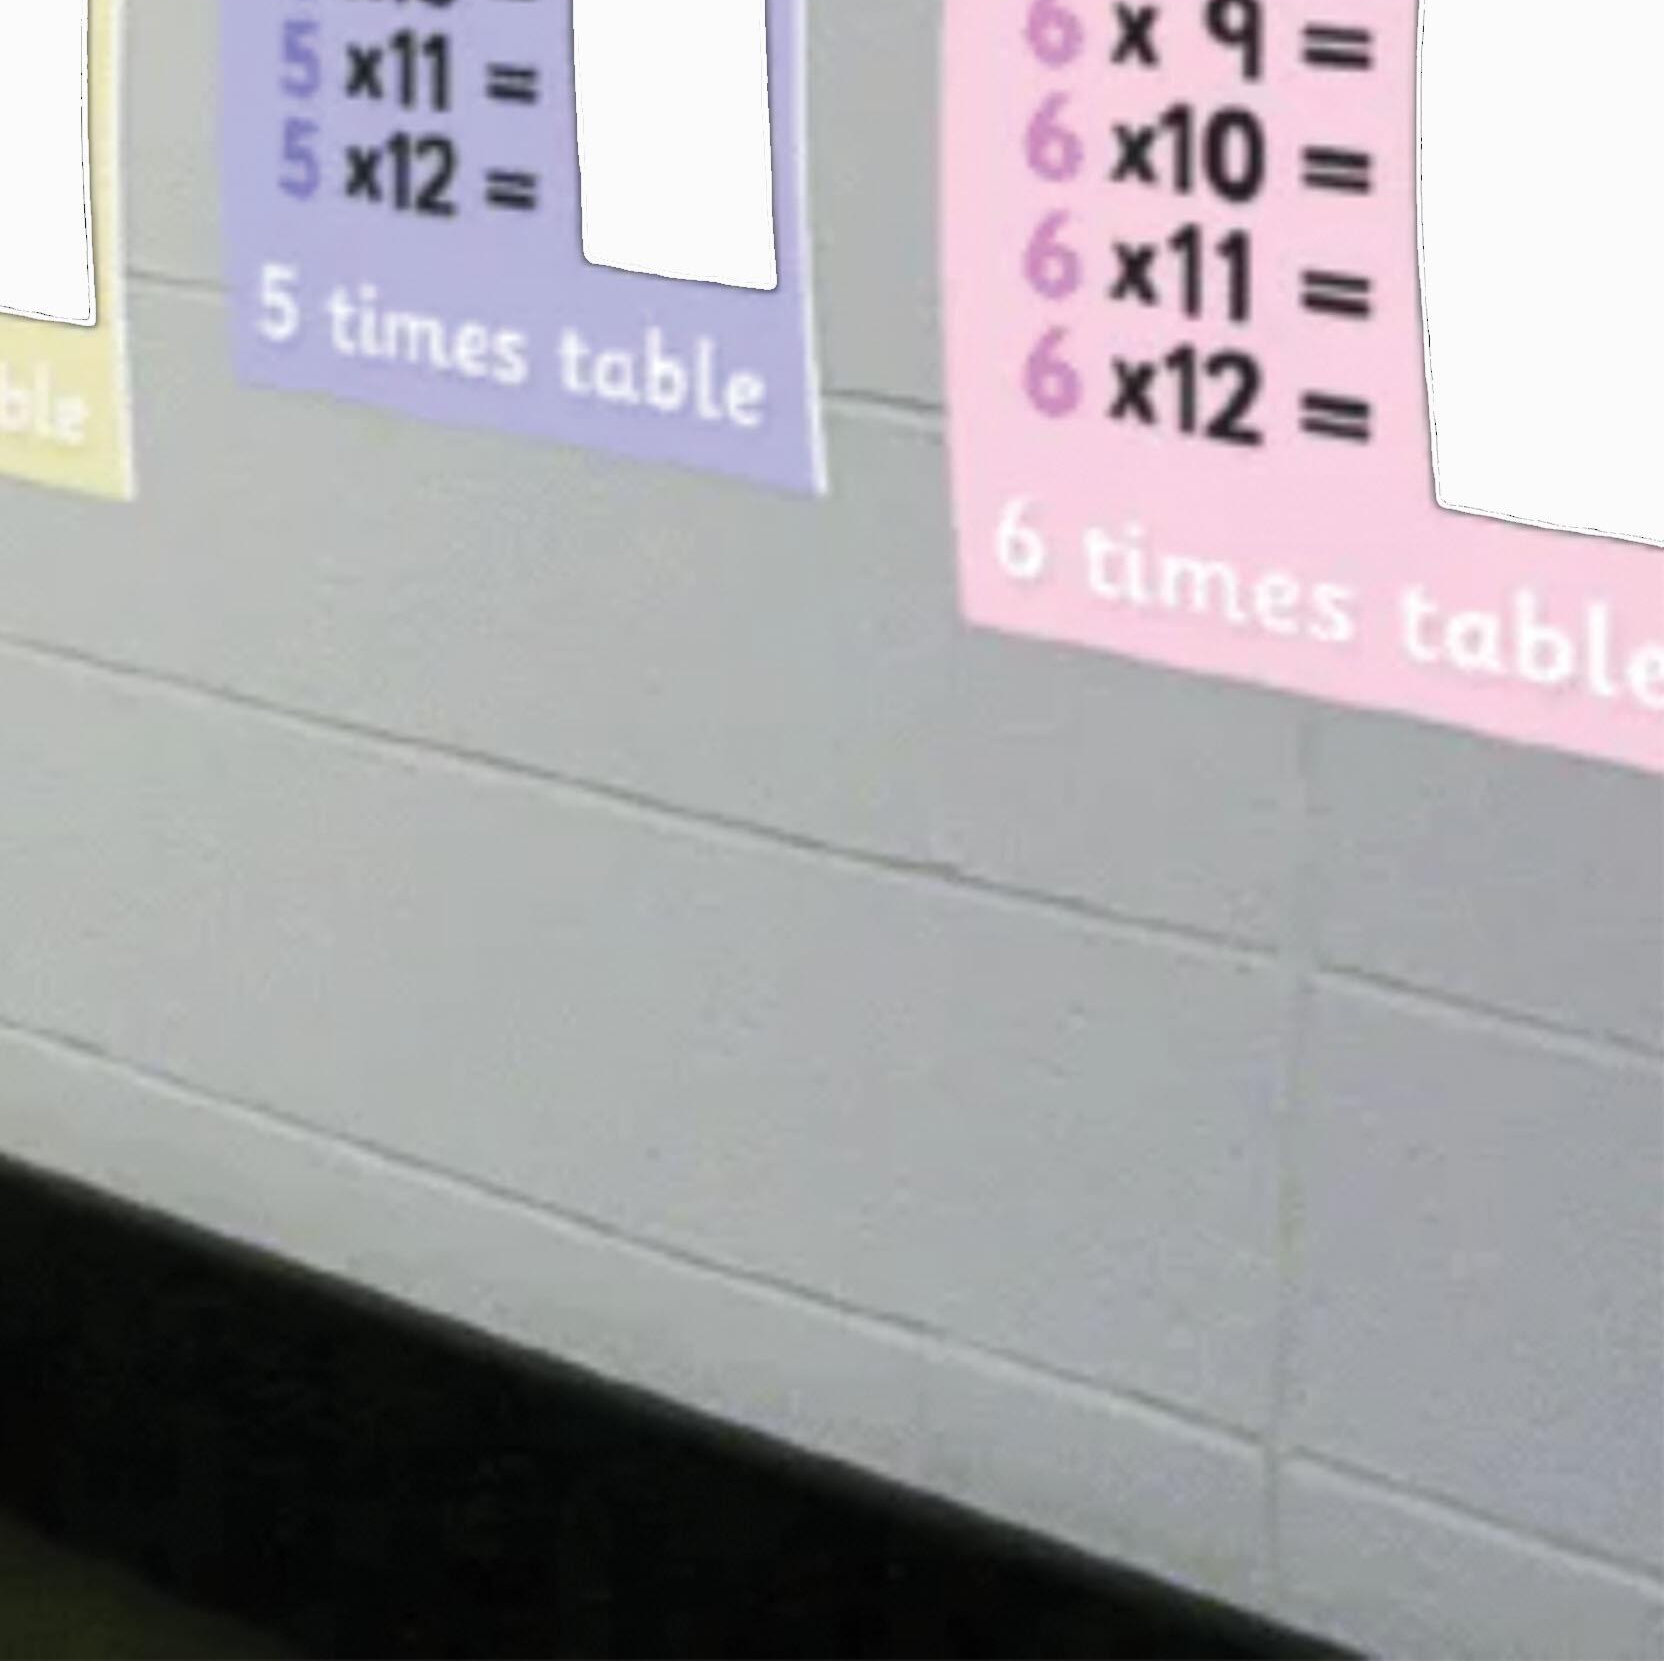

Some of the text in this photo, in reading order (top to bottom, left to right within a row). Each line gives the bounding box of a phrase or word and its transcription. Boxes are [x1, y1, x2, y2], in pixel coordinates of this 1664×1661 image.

[1111, 2, 1159, 67] x
[278, 117, 320, 201] 5
[1025, 92, 1084, 183] 6
[1111, 103, 1266, 204] x10
[257, 263, 766, 426] 5 times table
[1023, 326, 1082, 419] 6
[1109, 343, 1263, 447] x12
[995, 496, 1664, 710] 6 times table
